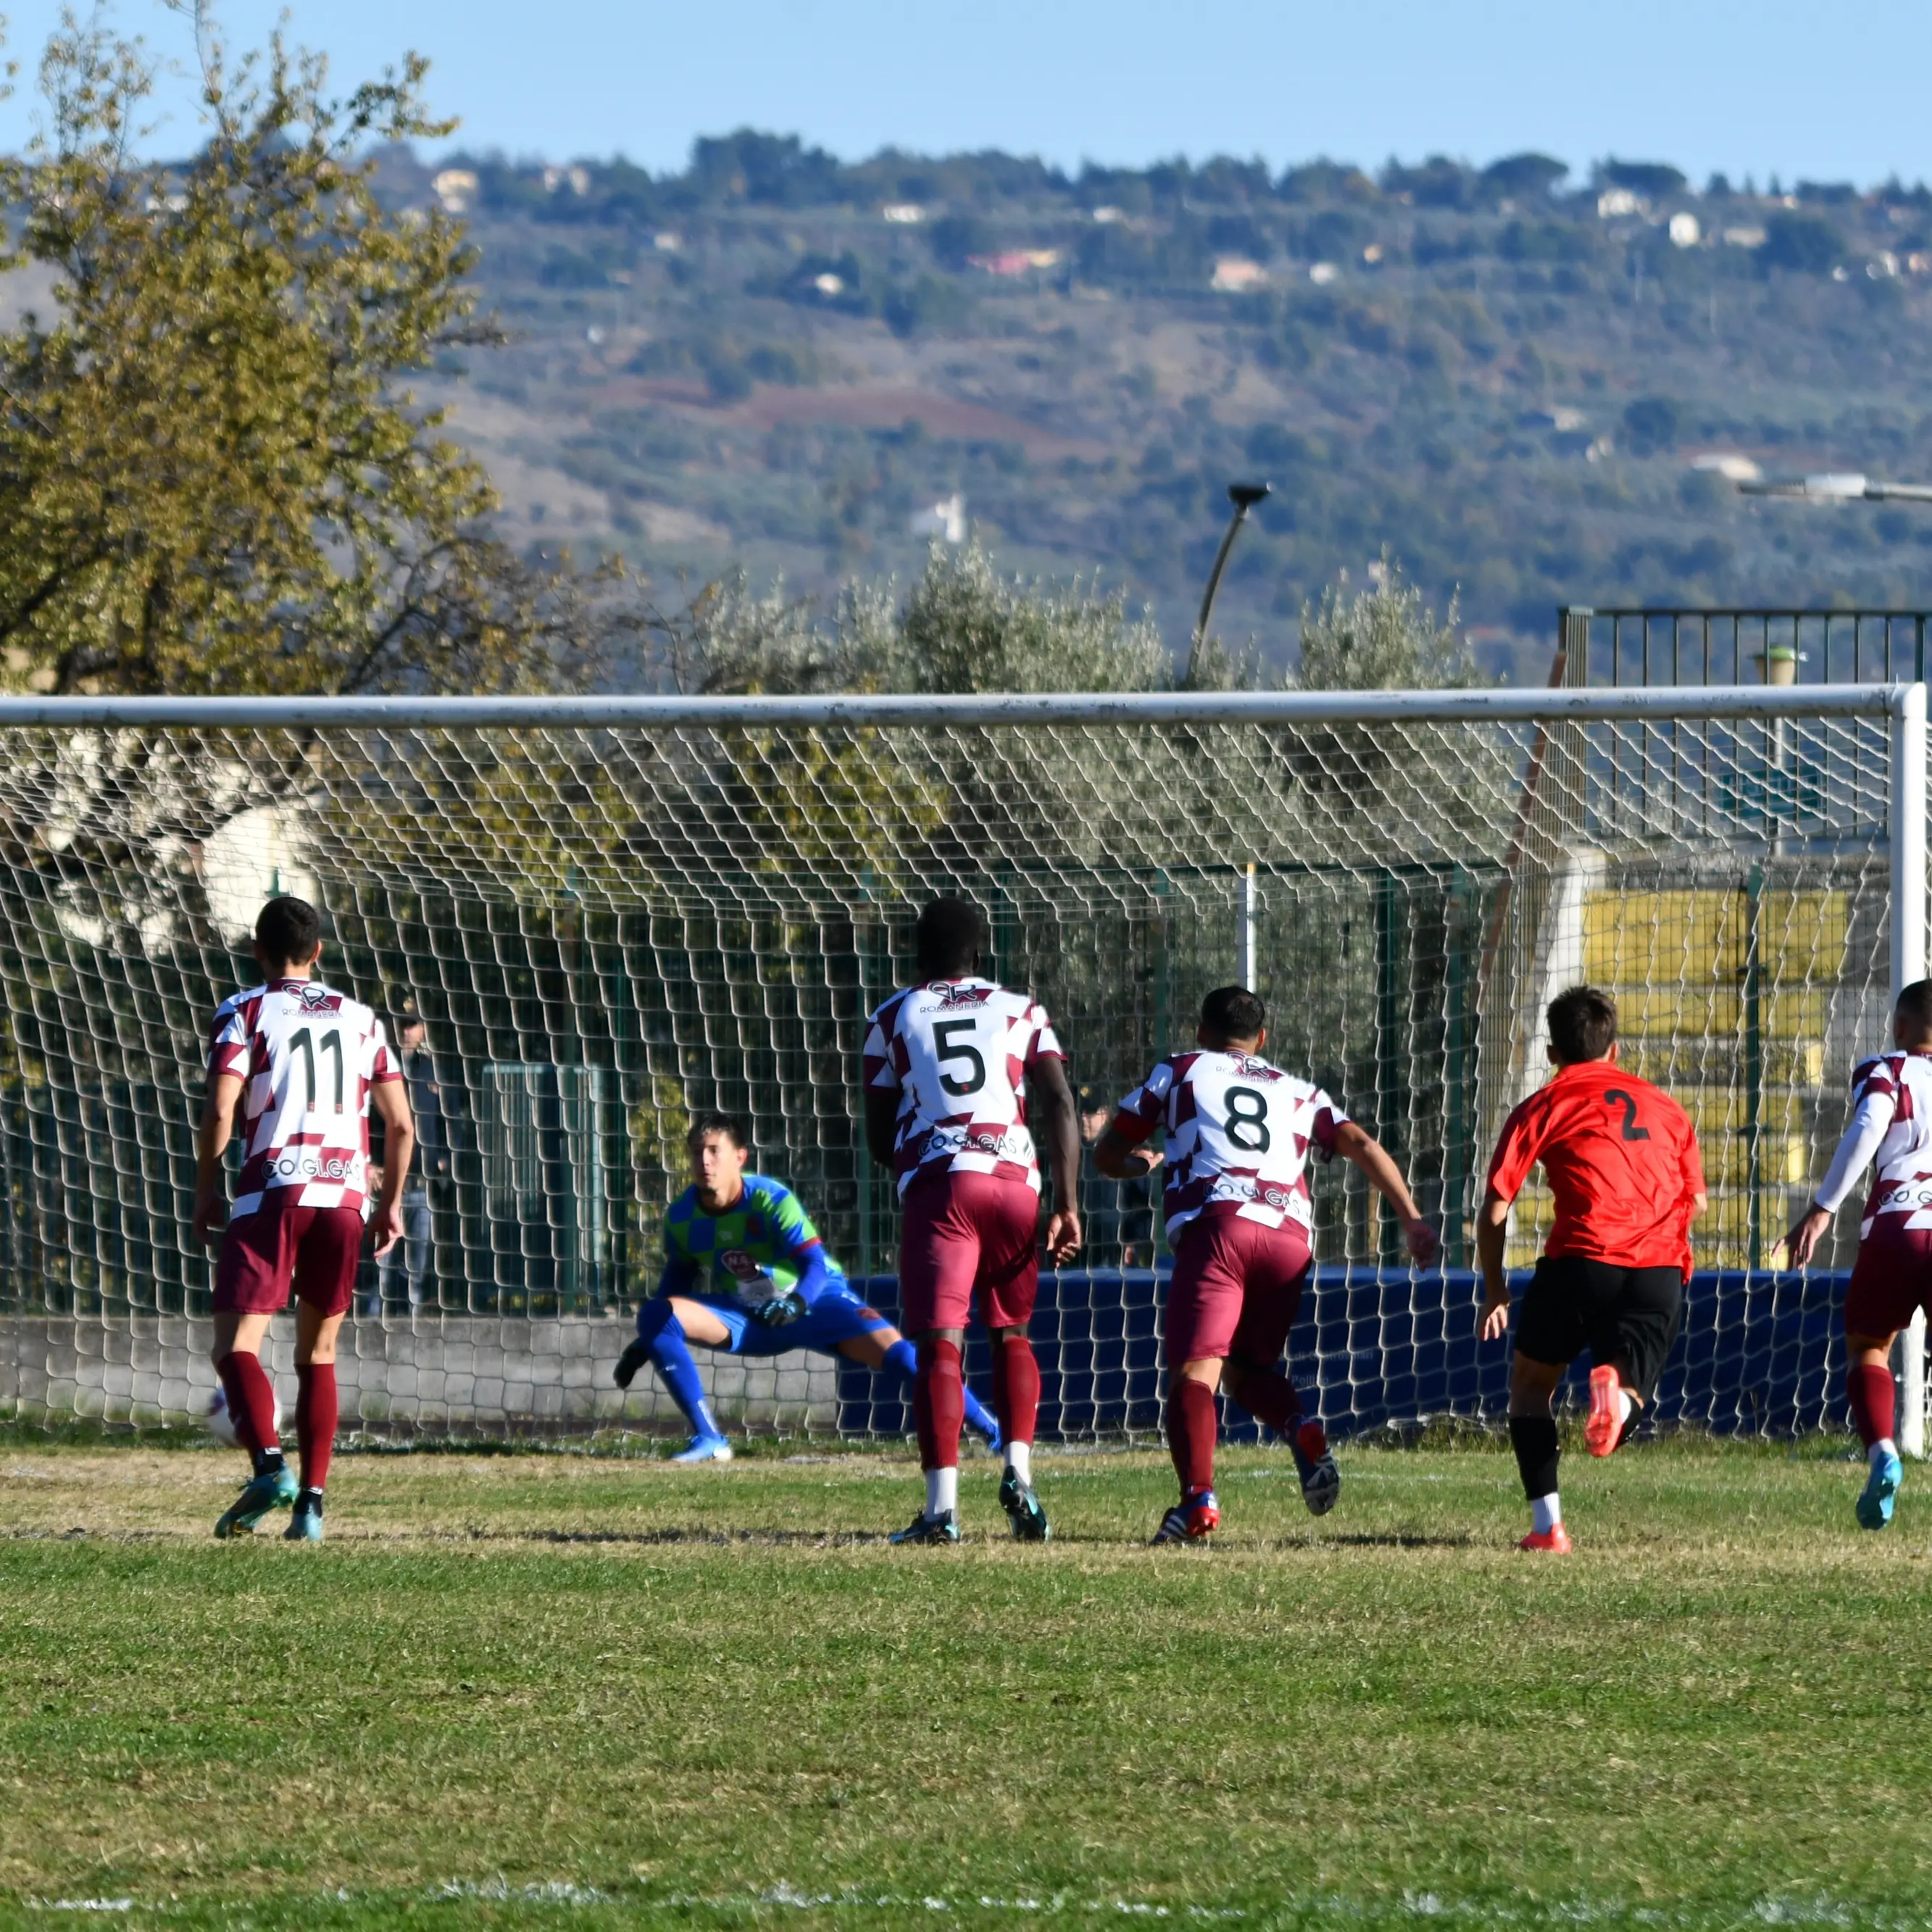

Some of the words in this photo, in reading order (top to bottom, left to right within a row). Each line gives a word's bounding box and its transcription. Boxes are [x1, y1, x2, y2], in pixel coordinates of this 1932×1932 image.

[288, 1028, 343, 1115] 11
[931, 1018, 986, 1097] 5
[1224, 1086, 1270, 1154] 8
[1603, 1088, 1651, 1141] 2
